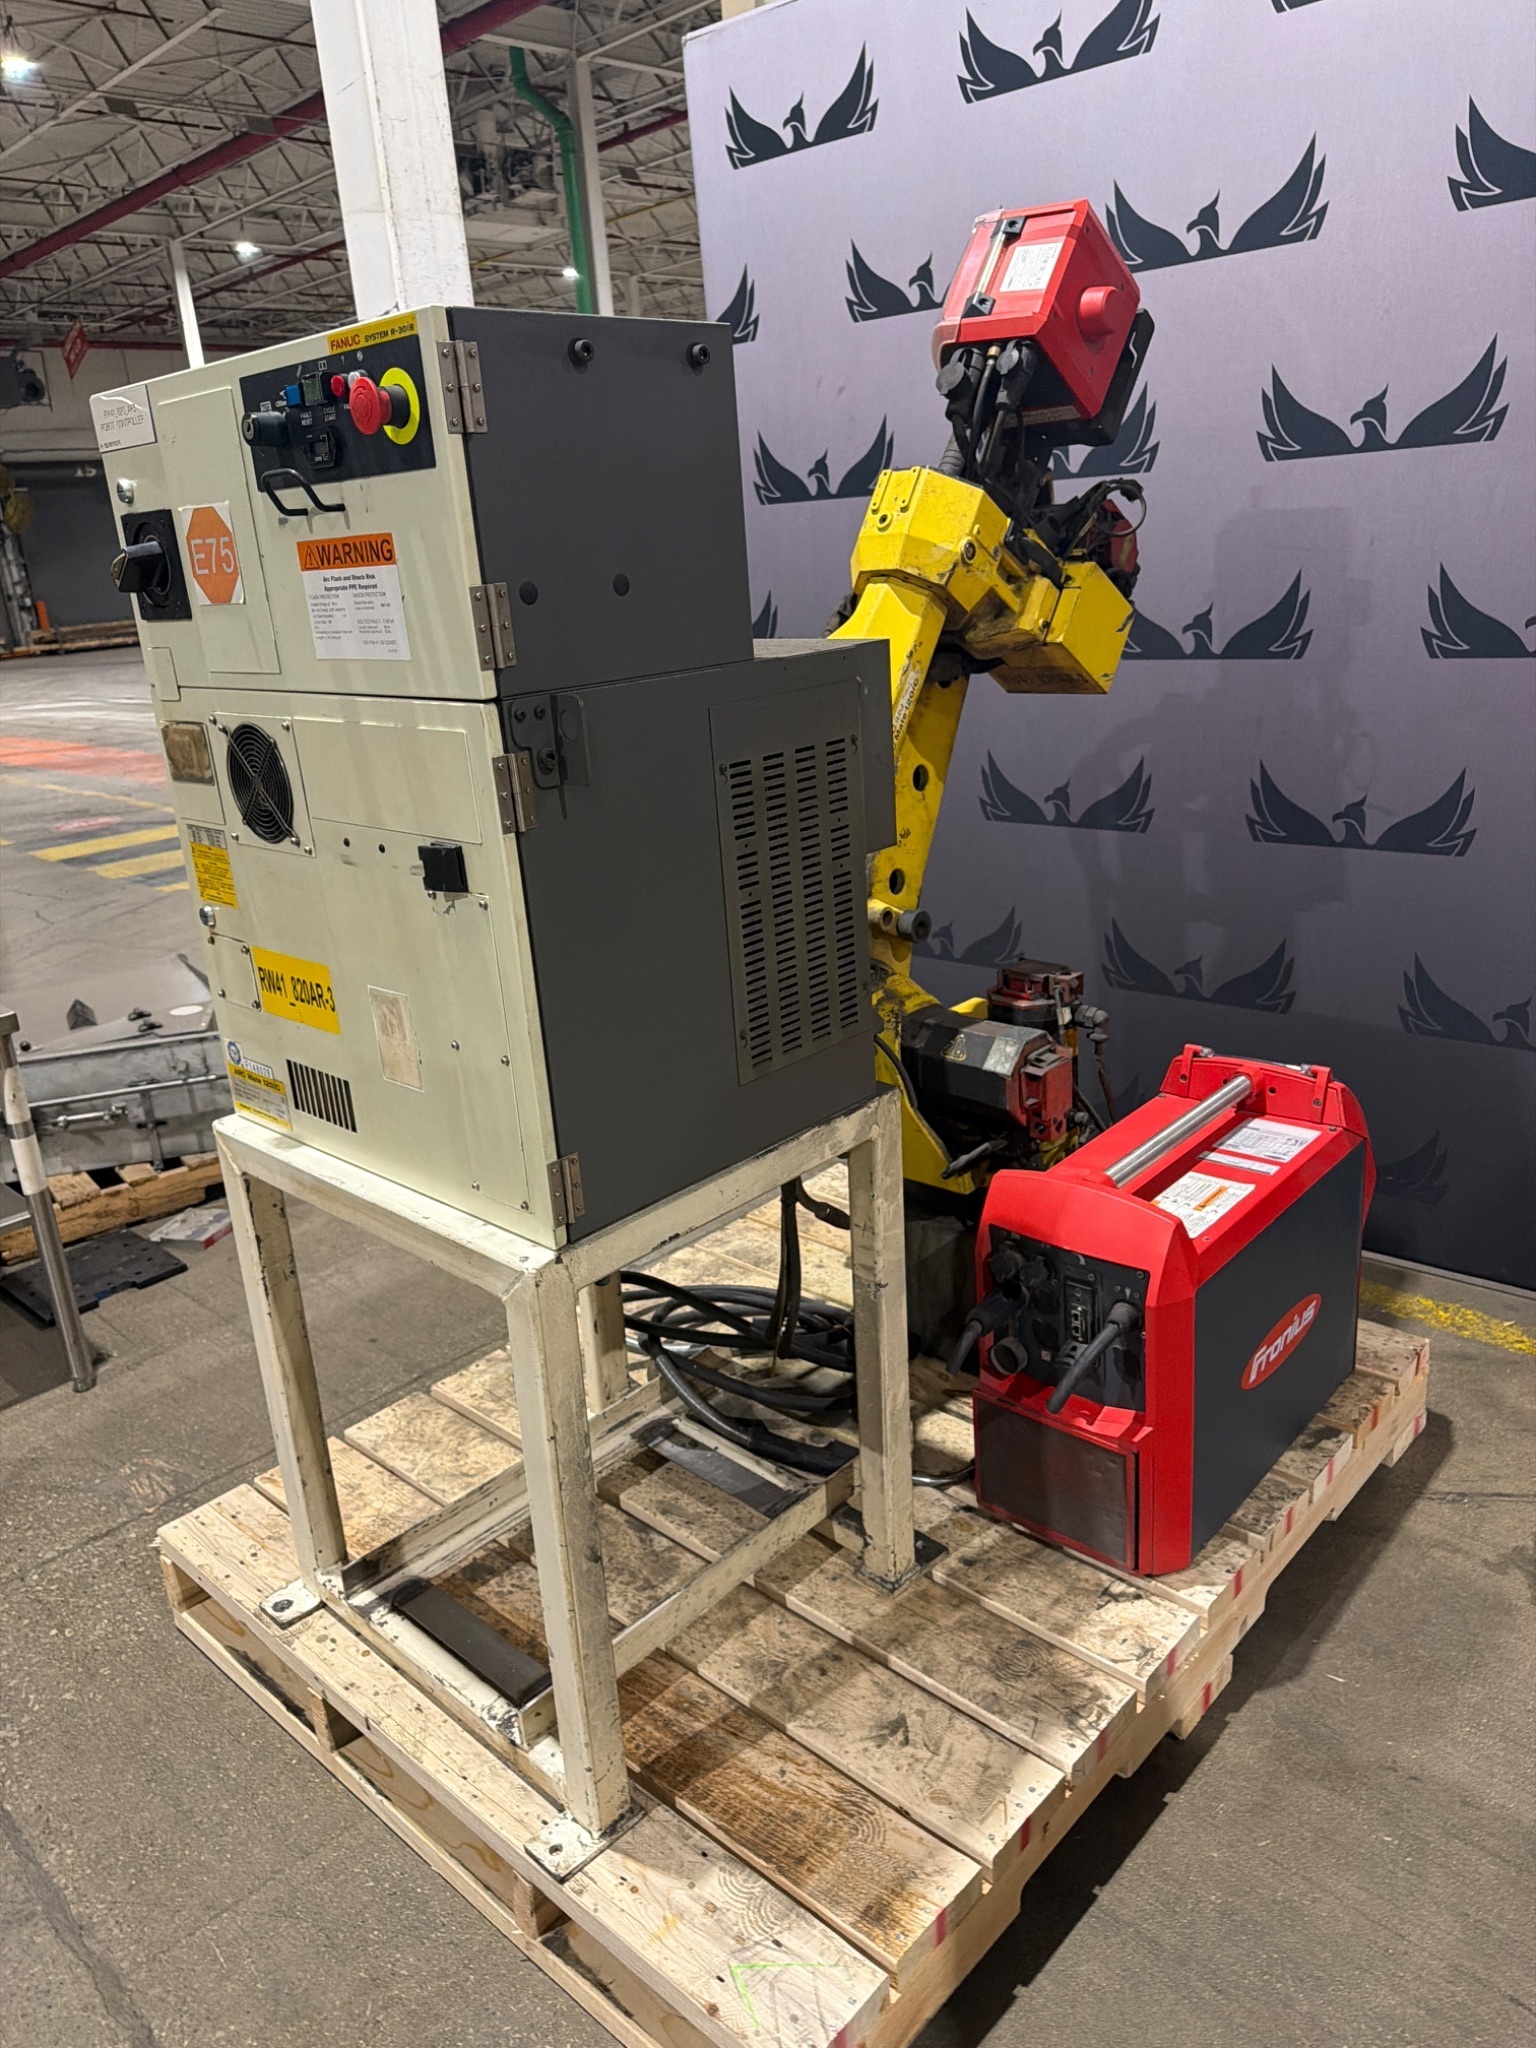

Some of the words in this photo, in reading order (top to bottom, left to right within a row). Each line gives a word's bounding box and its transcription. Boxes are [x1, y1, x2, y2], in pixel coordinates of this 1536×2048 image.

[330, 333, 361, 351] FANUC
[364, 330, 389, 343] SYSTEM
[190, 537, 235, 575] E75
[316, 539, 393, 566] WARNING
[324, 585, 348, 593] Appropriate
[358, 583, 378, 591] Required
[895, 713, 907, 740] Mate
[258, 966, 336, 1013] RW41_820AR-3
[1248, 1299, 1317, 1384] Fronius
